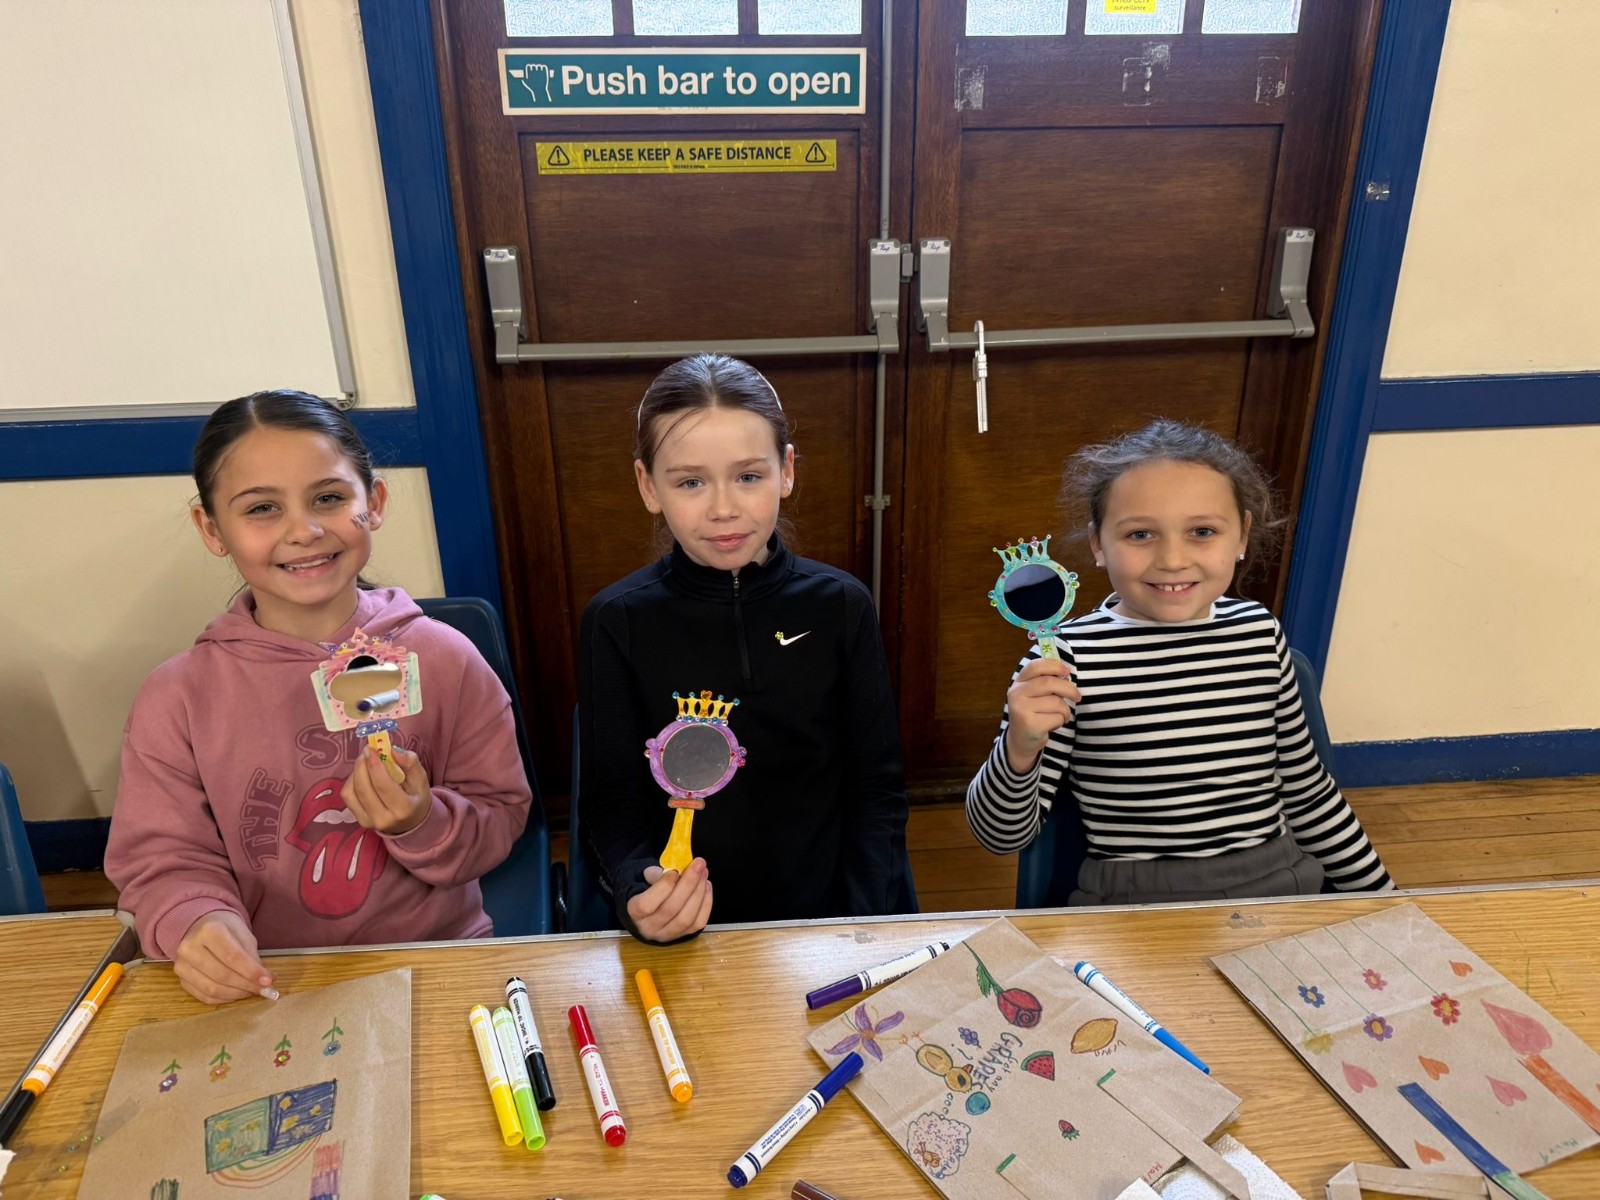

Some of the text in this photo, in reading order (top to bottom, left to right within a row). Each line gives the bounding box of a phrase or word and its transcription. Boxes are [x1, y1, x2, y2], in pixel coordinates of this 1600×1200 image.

[561, 65, 851, 101] Push bar to open
[584, 147, 791, 162] PLEASE KEEP A SAFE DISTANCE
[240, 768, 295, 871] THE
[972, 1032, 1023, 1090] GRAPES
